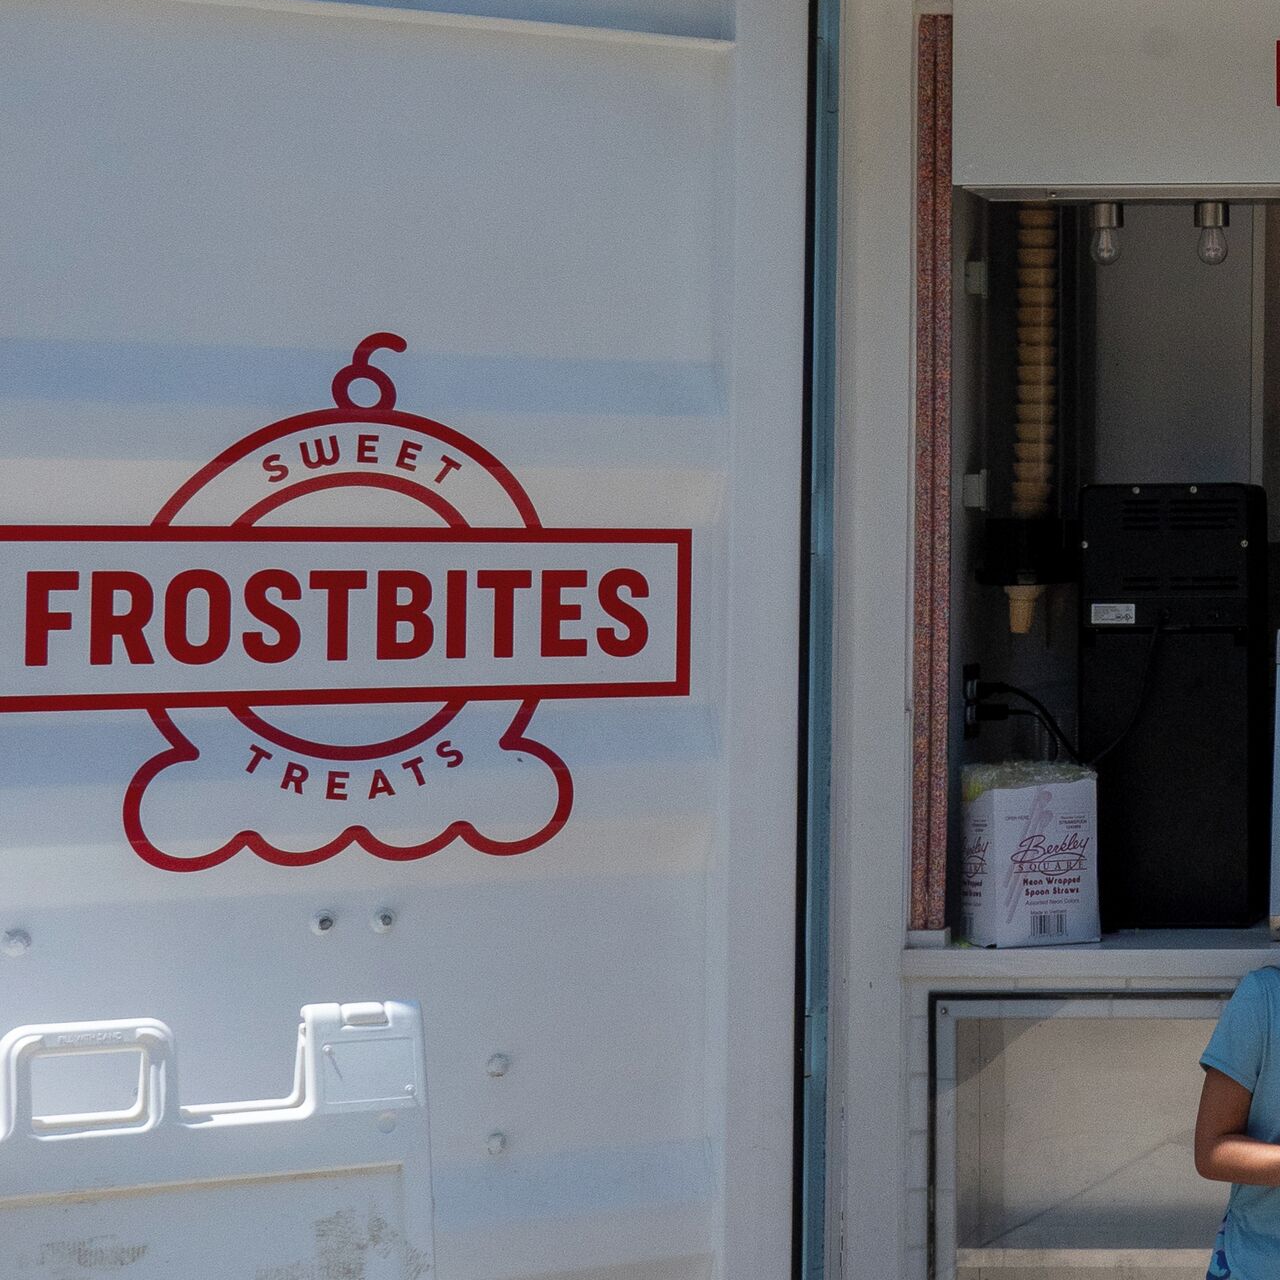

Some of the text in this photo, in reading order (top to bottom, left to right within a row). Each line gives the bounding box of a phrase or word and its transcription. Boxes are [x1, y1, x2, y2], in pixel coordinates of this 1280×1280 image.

[262, 434, 462, 485] SWEET
[24, 568, 649, 667] FROSTBITES
[245, 740, 464, 801] TREATS
[1011, 833, 1089, 863] Berkley
[1018, 859, 1085, 872] SQUARE
[1025, 887, 1080, 898] Spoon Straws
[1045, 875, 1081, 887] Wrapped
